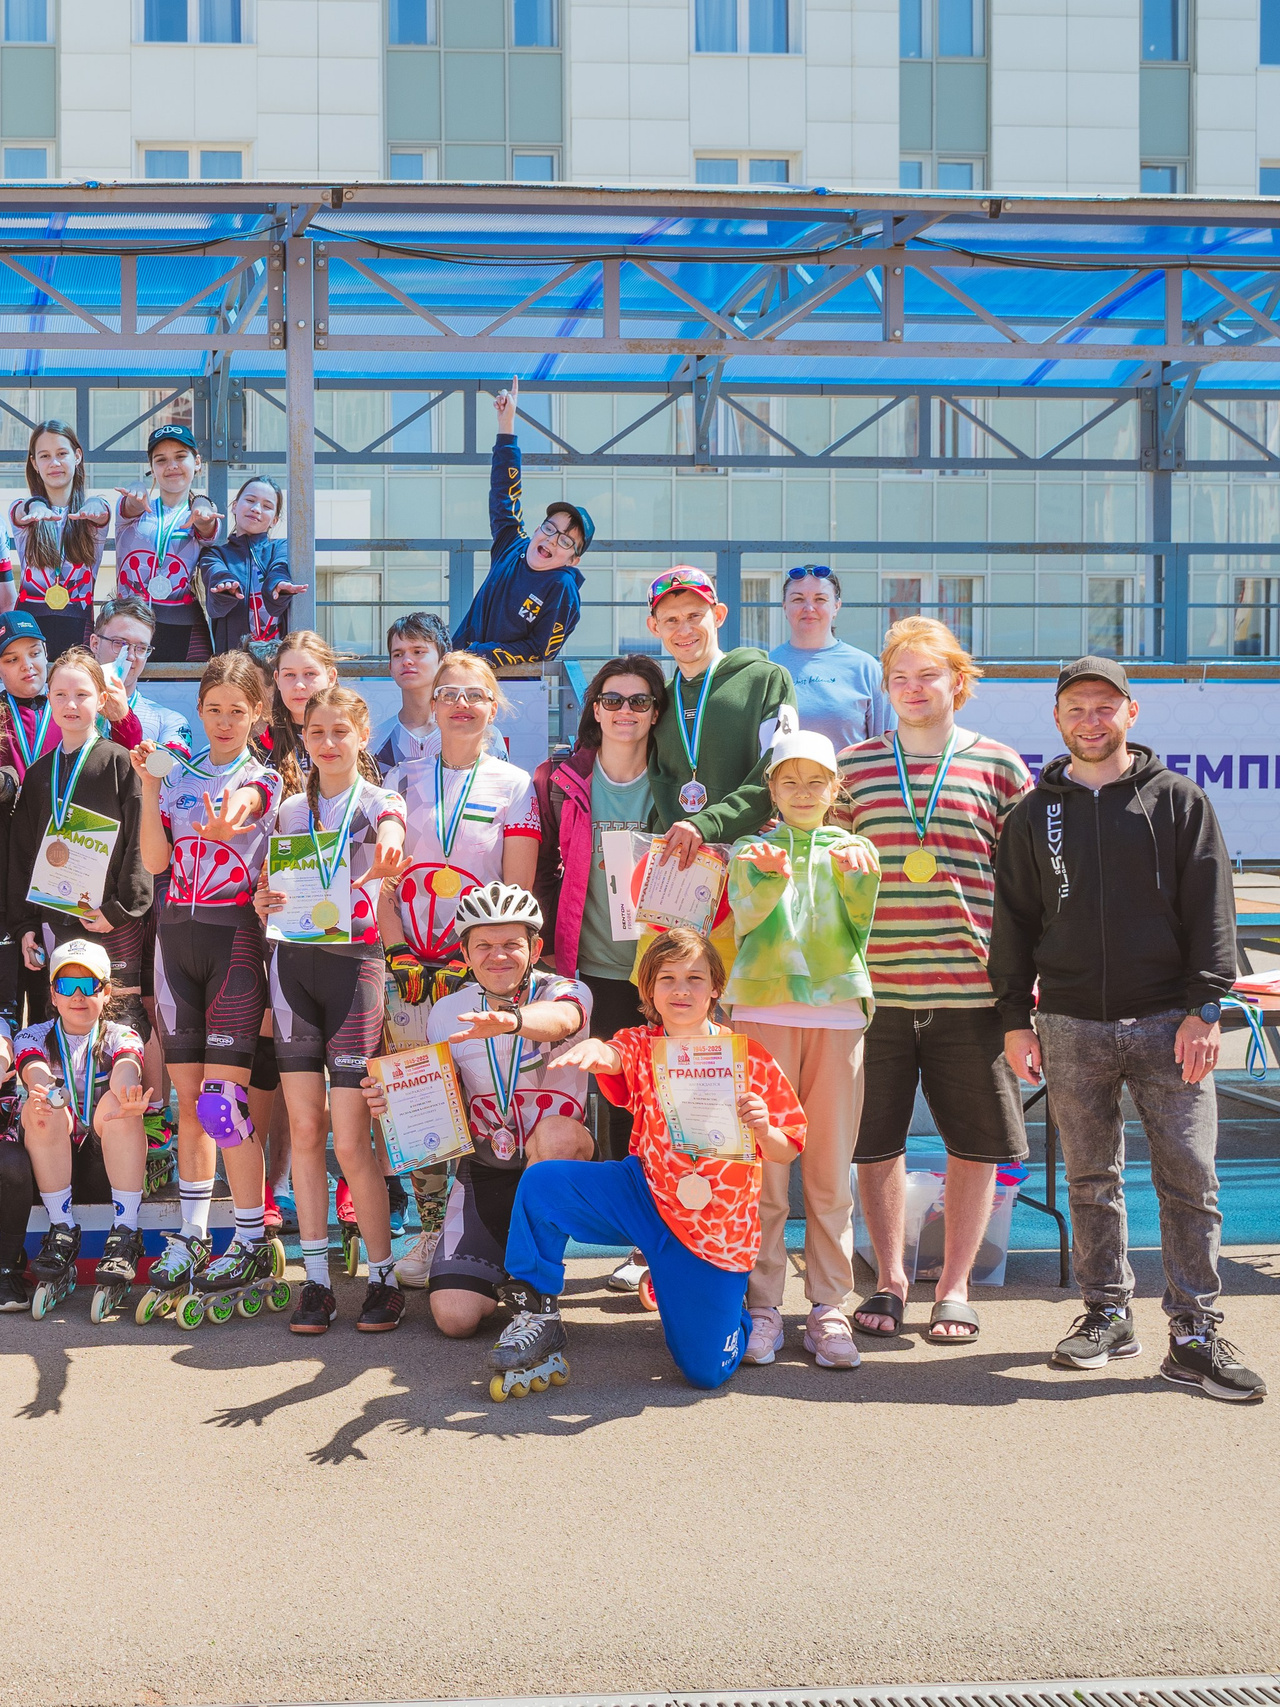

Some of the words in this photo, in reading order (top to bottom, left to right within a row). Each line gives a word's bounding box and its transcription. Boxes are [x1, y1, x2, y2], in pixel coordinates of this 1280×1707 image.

[1156, 754, 1280, 789] ЕМП
[386, 1071, 442, 1093] ГРАМОТА
[668, 1068, 734, 1079] ГРАМОТА
